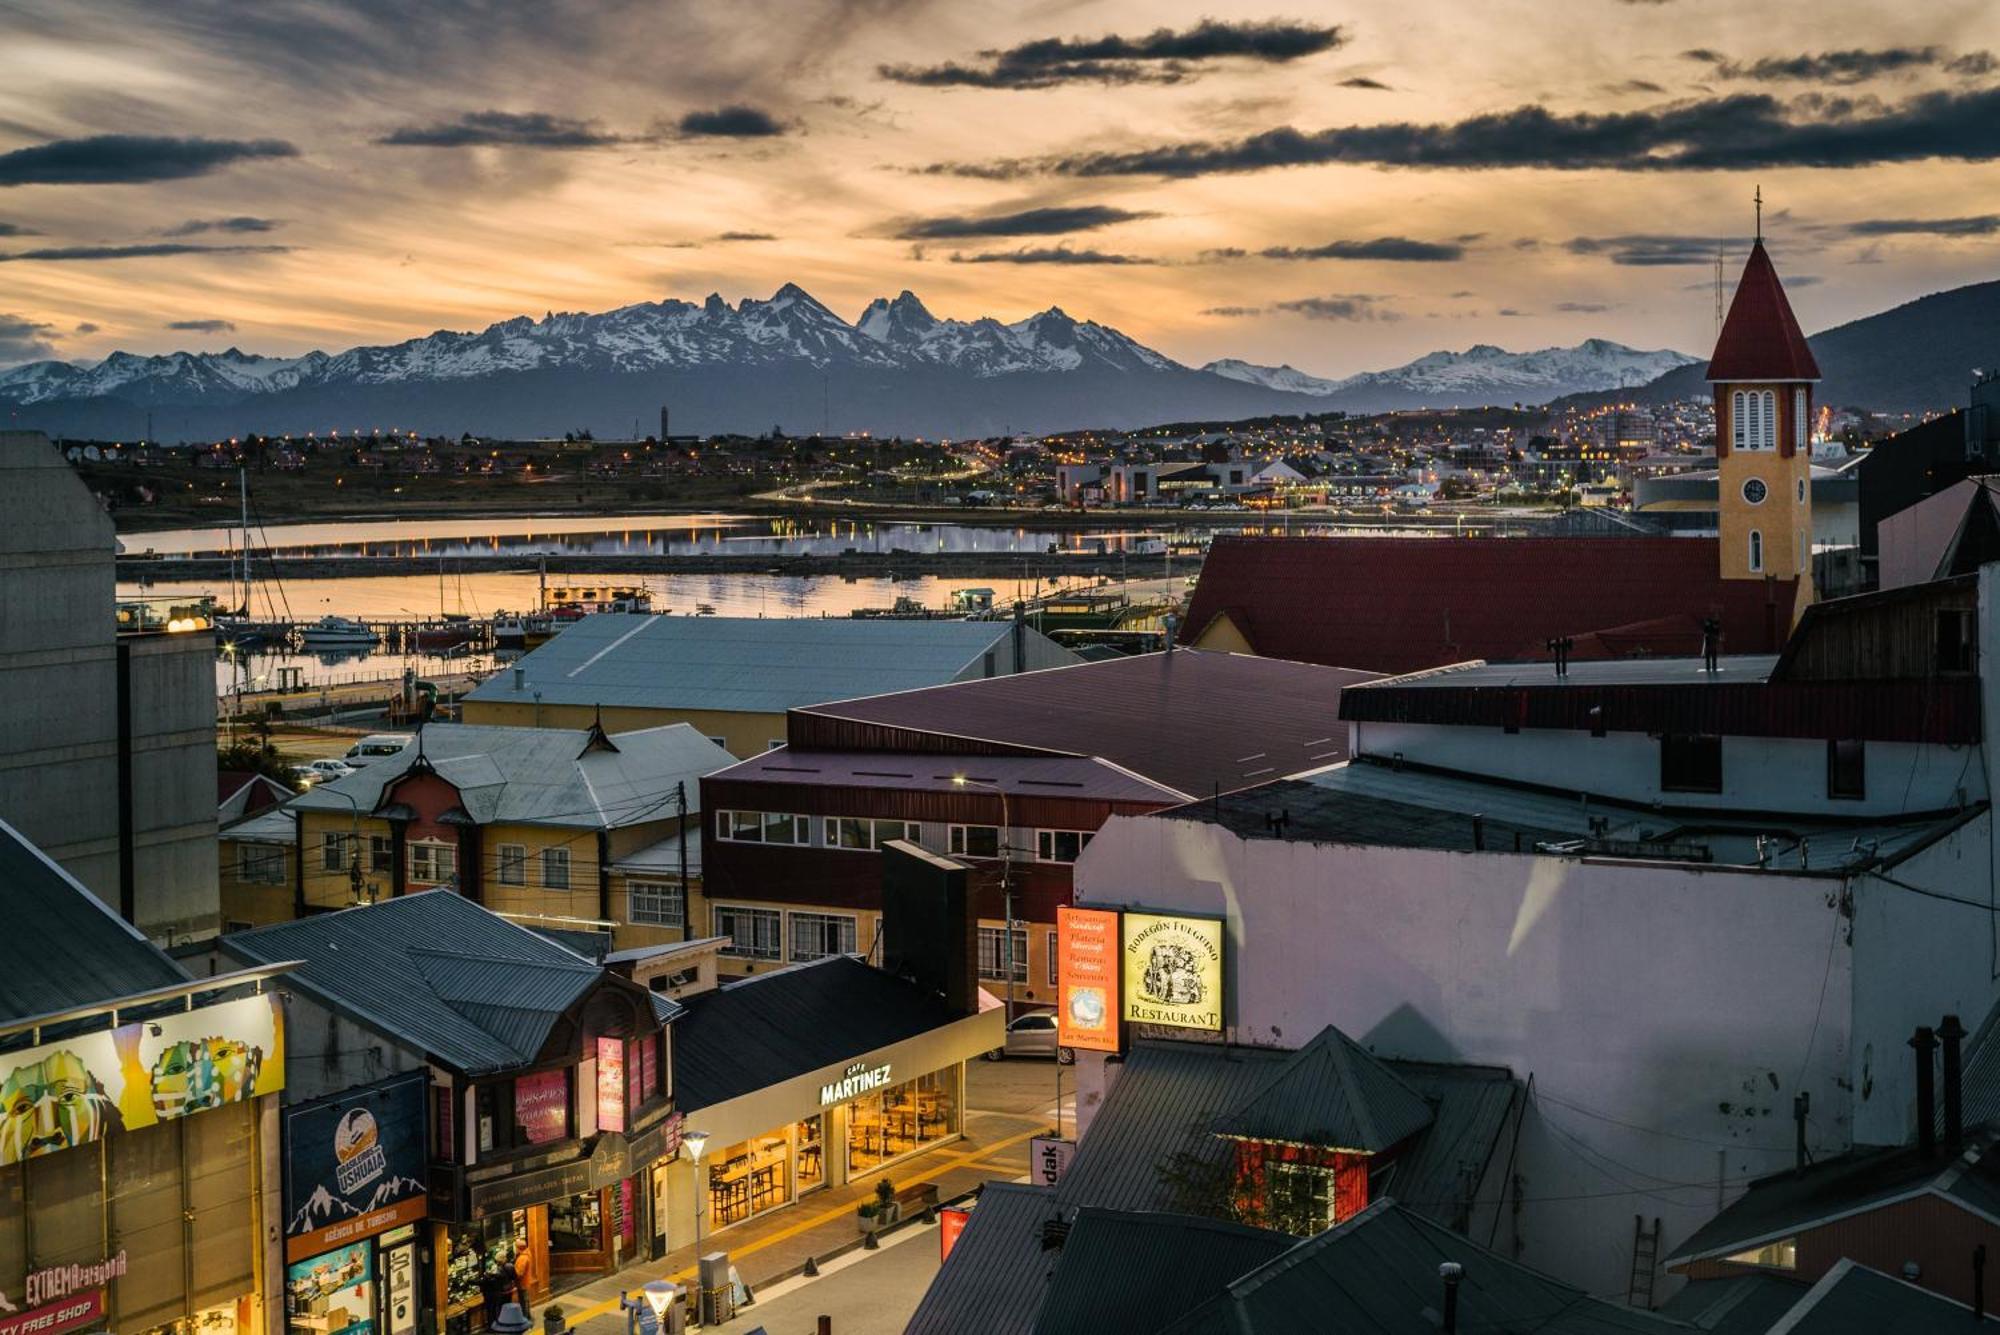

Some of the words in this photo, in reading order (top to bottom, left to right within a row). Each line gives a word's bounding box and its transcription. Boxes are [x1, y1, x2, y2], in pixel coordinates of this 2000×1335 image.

[1128, 921, 1171, 954] BODEGÓN
[1174, 921, 1218, 962] FUEGUINO
[1131, 1005, 1218, 1026] RESTAURANT
[821, 1064, 891, 1106] MARTINEZ
[340, 1153, 386, 1191] USHUAIA
[21, 1313, 55, 1335] FREE
[56, 1301, 92, 1323] SHOP
